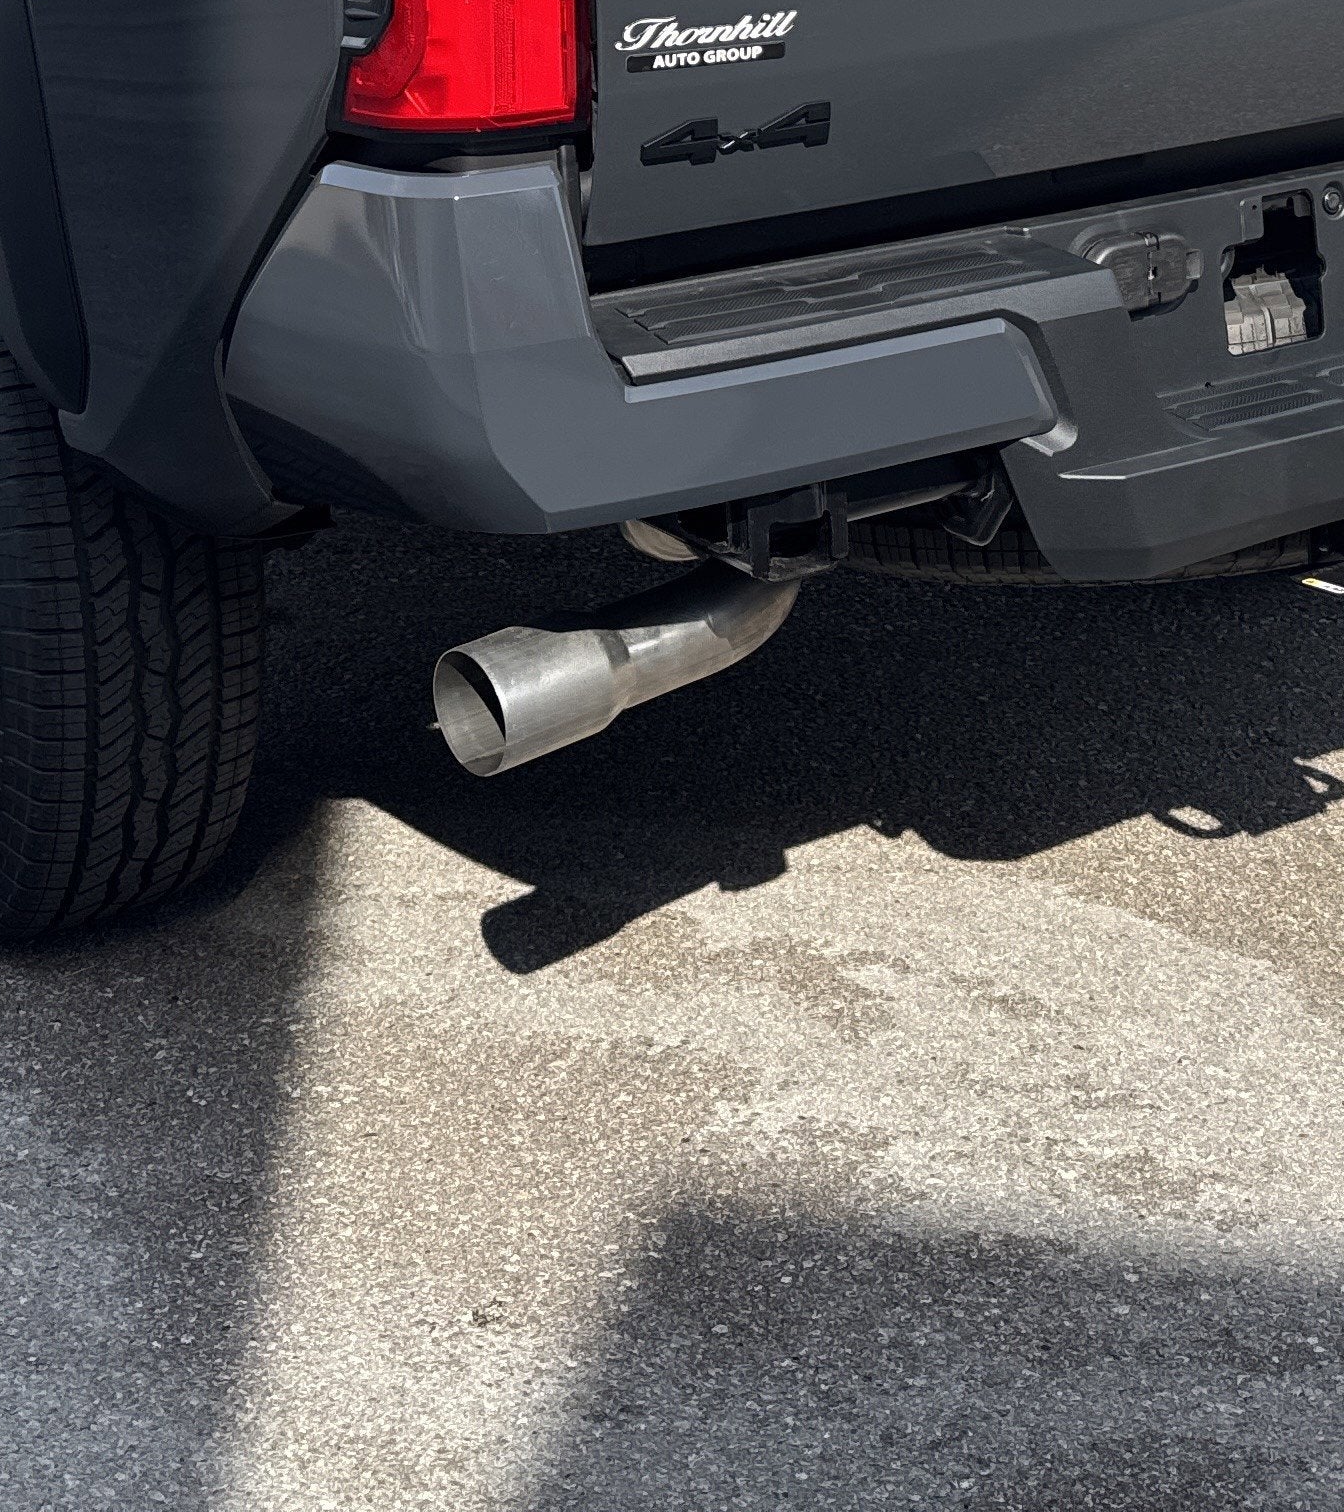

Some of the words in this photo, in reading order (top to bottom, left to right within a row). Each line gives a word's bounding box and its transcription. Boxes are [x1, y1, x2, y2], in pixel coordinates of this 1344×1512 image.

[614, 9, 798, 52] Thornhill
[652, 51, 700, 69] AUTO
[703, 45, 763, 65] GROUP
